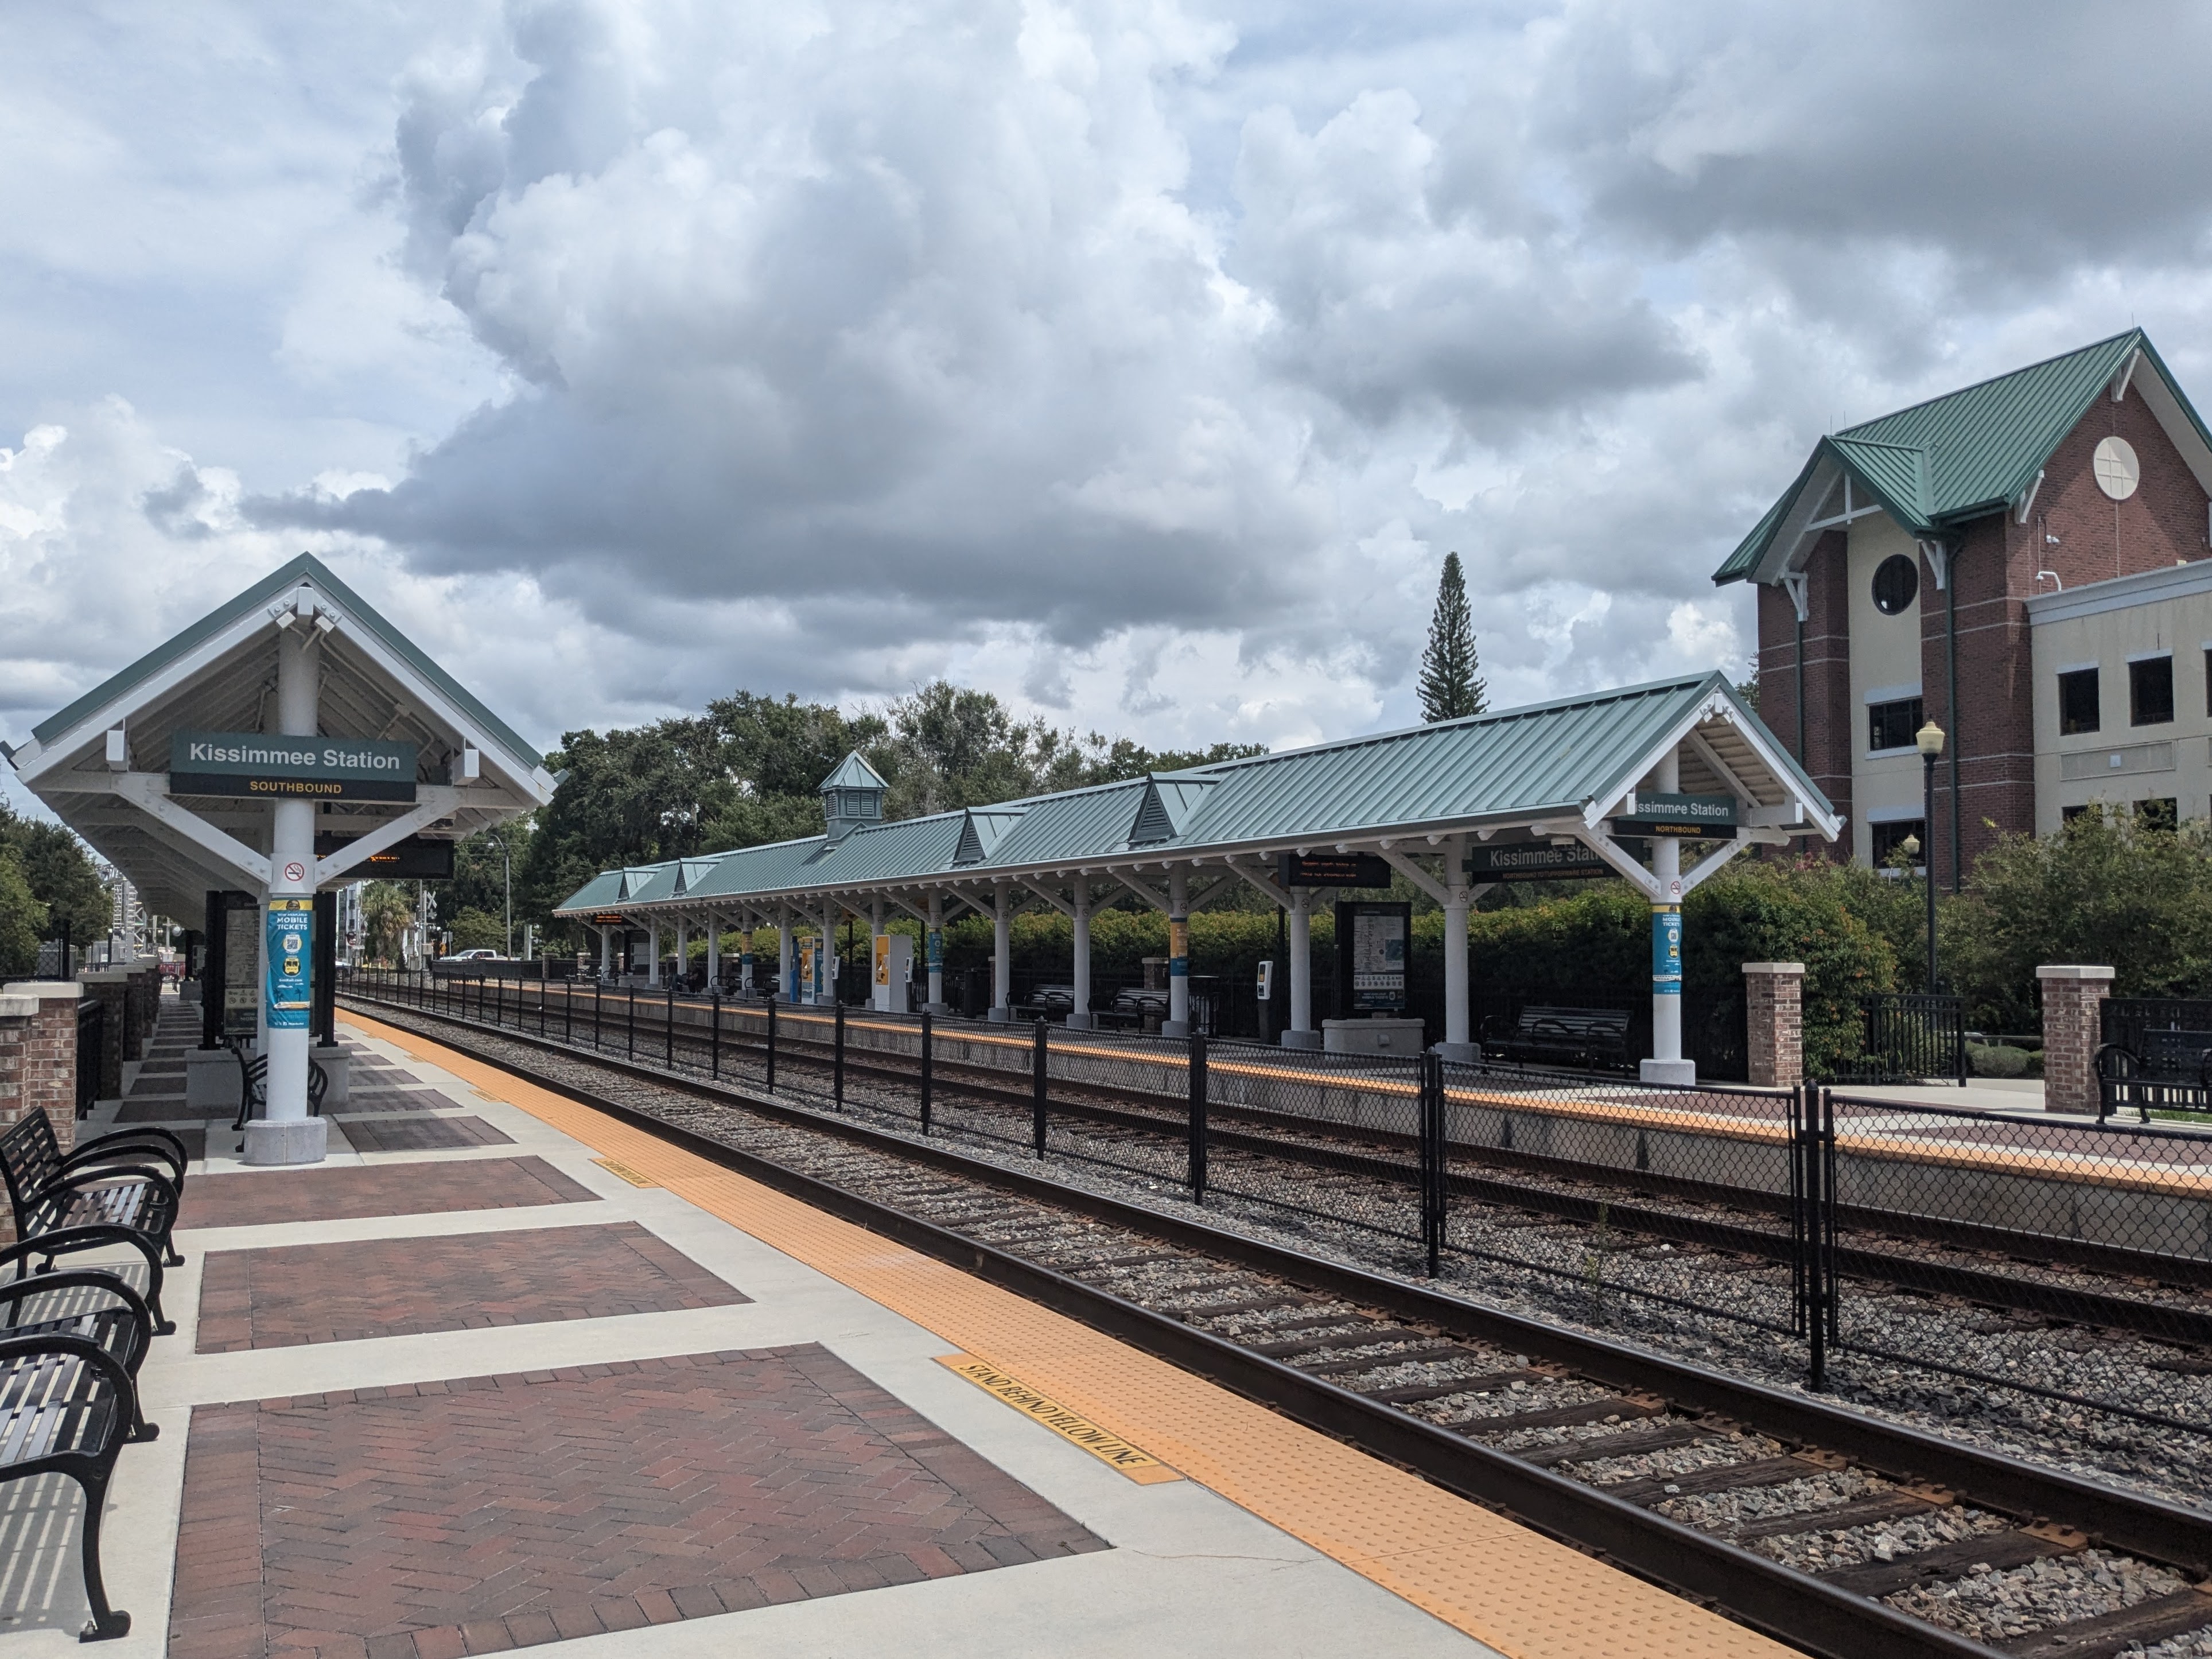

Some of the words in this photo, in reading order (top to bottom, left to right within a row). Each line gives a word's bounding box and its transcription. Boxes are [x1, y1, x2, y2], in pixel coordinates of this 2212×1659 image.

[191, 743, 316, 766] Kissimmee
[323, 749, 400, 770] Station
[250, 781, 342, 794] SOUTHBOUND
[1635, 801, 1688, 815] issimmee
[1690, 803, 1729, 817] Station
[1655, 825, 1701, 834] NORTHBOUND
[1490, 848, 1562, 867] Kissimmee
[959, 1365, 1013, 1386] STAND
[996, 1386, 1059, 1414] BEHIND
[1041, 1412, 1114, 1446] YELLOW
[1093, 1443, 1148, 1464] LINE
